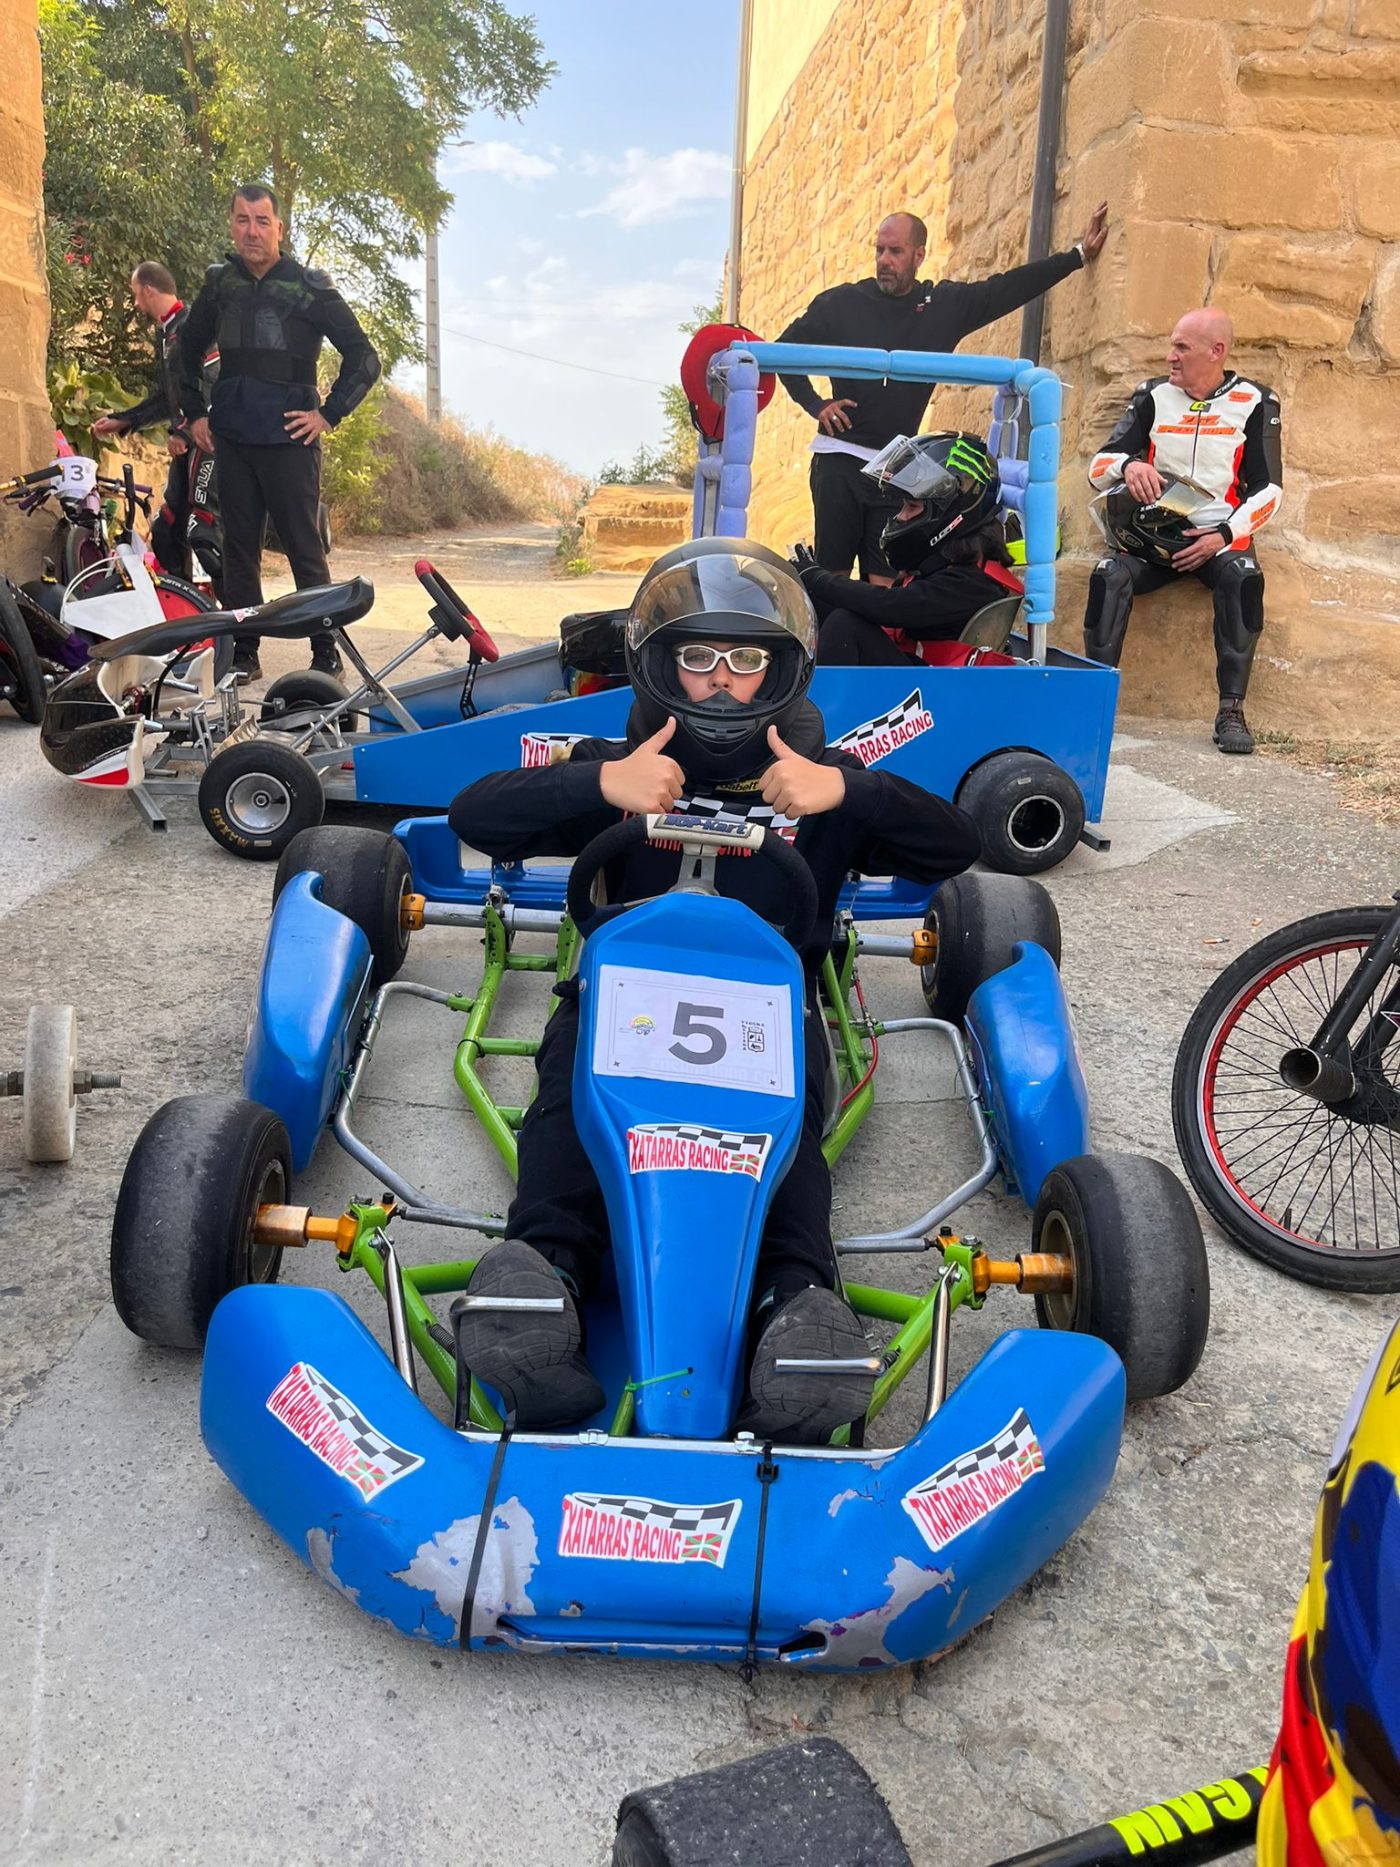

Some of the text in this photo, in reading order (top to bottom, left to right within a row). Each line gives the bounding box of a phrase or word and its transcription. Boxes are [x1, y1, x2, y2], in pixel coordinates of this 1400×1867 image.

[522, 737, 550, 768] TXATA
[890, 712, 932, 747] RACING
[667, 1001, 727, 1065] 5
[688, 1140, 729, 1171] RACING
[266, 1364, 360, 1471] TXATARRAS RACING
[560, 1498, 682, 1560] TXATARRAS RACING
[909, 1459, 1022, 1546] TXATARRAS RACING
